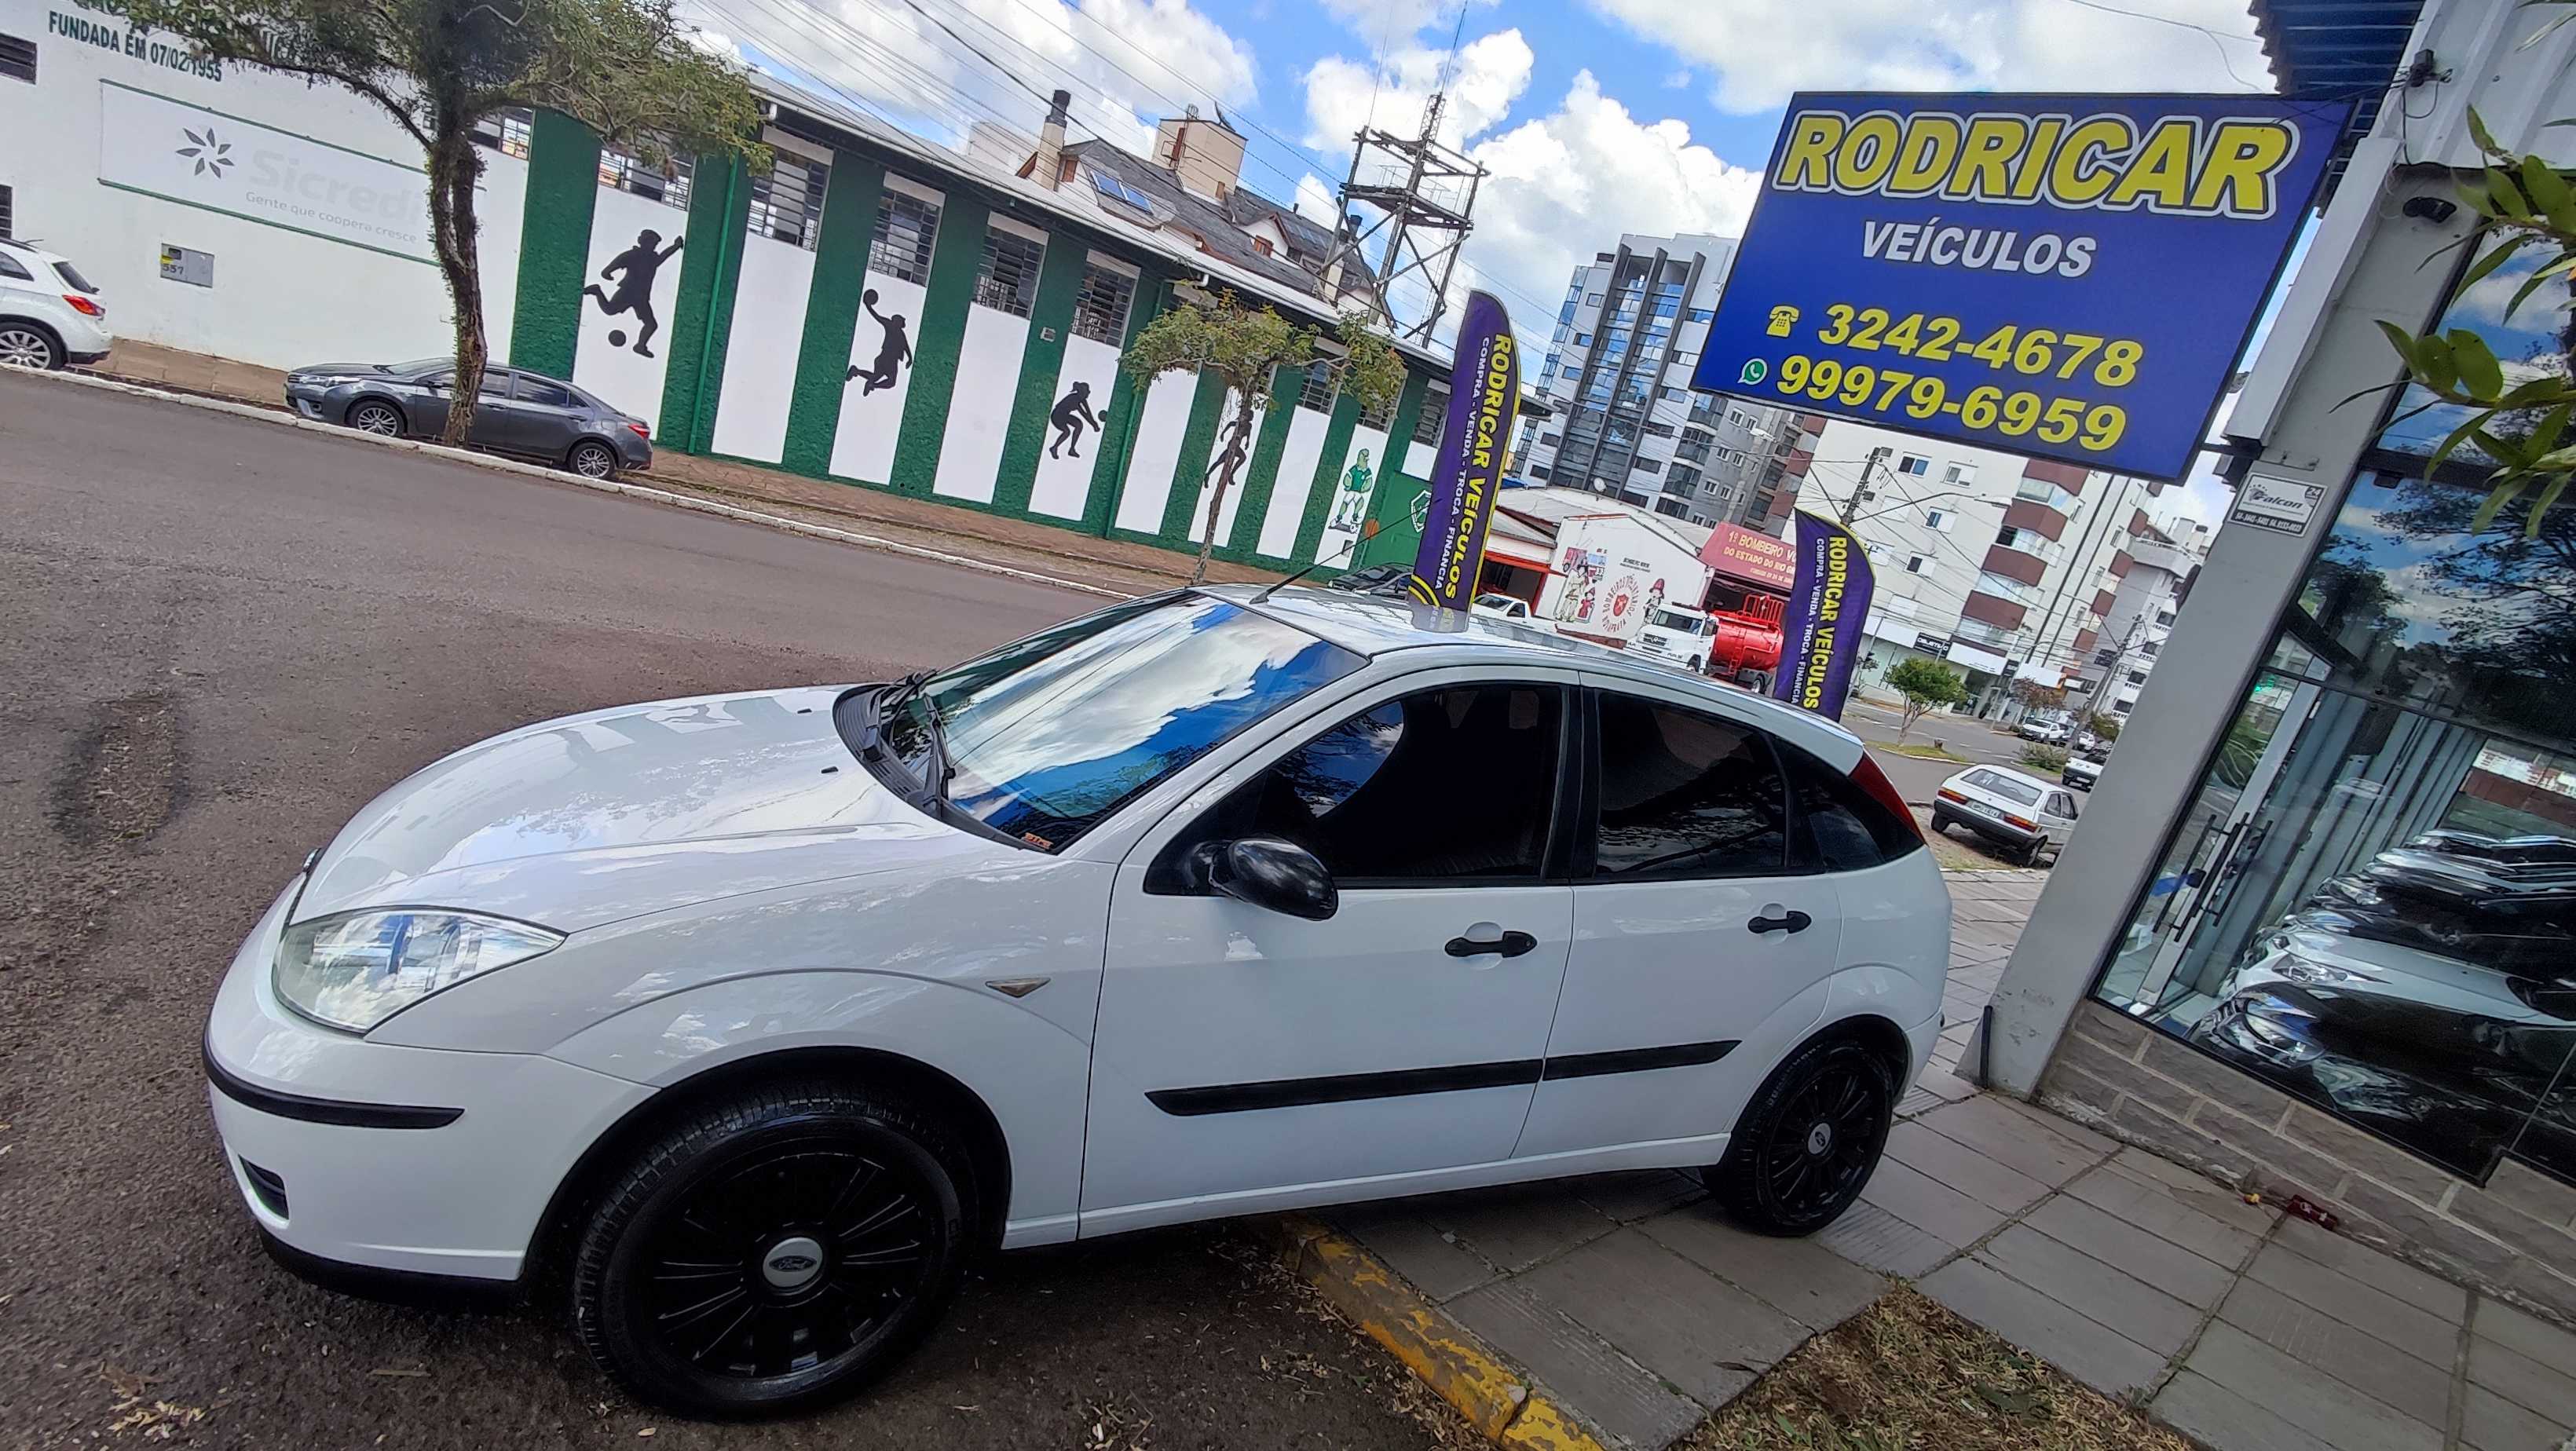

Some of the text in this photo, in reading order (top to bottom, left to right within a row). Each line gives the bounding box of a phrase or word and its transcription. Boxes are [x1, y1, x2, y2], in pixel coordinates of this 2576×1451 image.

[48, 10, 222, 82] FUNDADA EM 07/02/1955
[248, 148, 422, 225] Sicredi
[1774, 111, 2296, 217] RODRICAR
[245, 192, 417, 244] Gente que coopera cresce
[1861, 215, 2098, 279] VEÍCULOS
[1473, 337, 1490, 399] COMPRA
[1817, 303, 2143, 389] 3242-4678
[1776, 354, 2128, 453] 99979-6959
[1462, 410, 1477, 458] VENDA
[1445, 334, 1512, 599] RODRICAR VEÍCULOS
[1451, 470, 1468, 516] TROCA
[2250, 490, 2303, 509] Falcon
[1435, 526, 1456, 590] FINANCIA
[1723, 546, 1735, 556] DO
[1735, 550, 1763, 565] ESTADO
[1763, 558, 1773, 568] DO
[1738, 534, 1784, 557] BOMBEIRO
[1816, 538, 1825, 578] COMPRA
[1803, 536, 1847, 708] RODRICAR VEÍCULOS
[1808, 585, 1822, 616] VENDA
[1800, 623, 1814, 654] TROCA
[1791, 661, 1806, 704] FINANCIA
